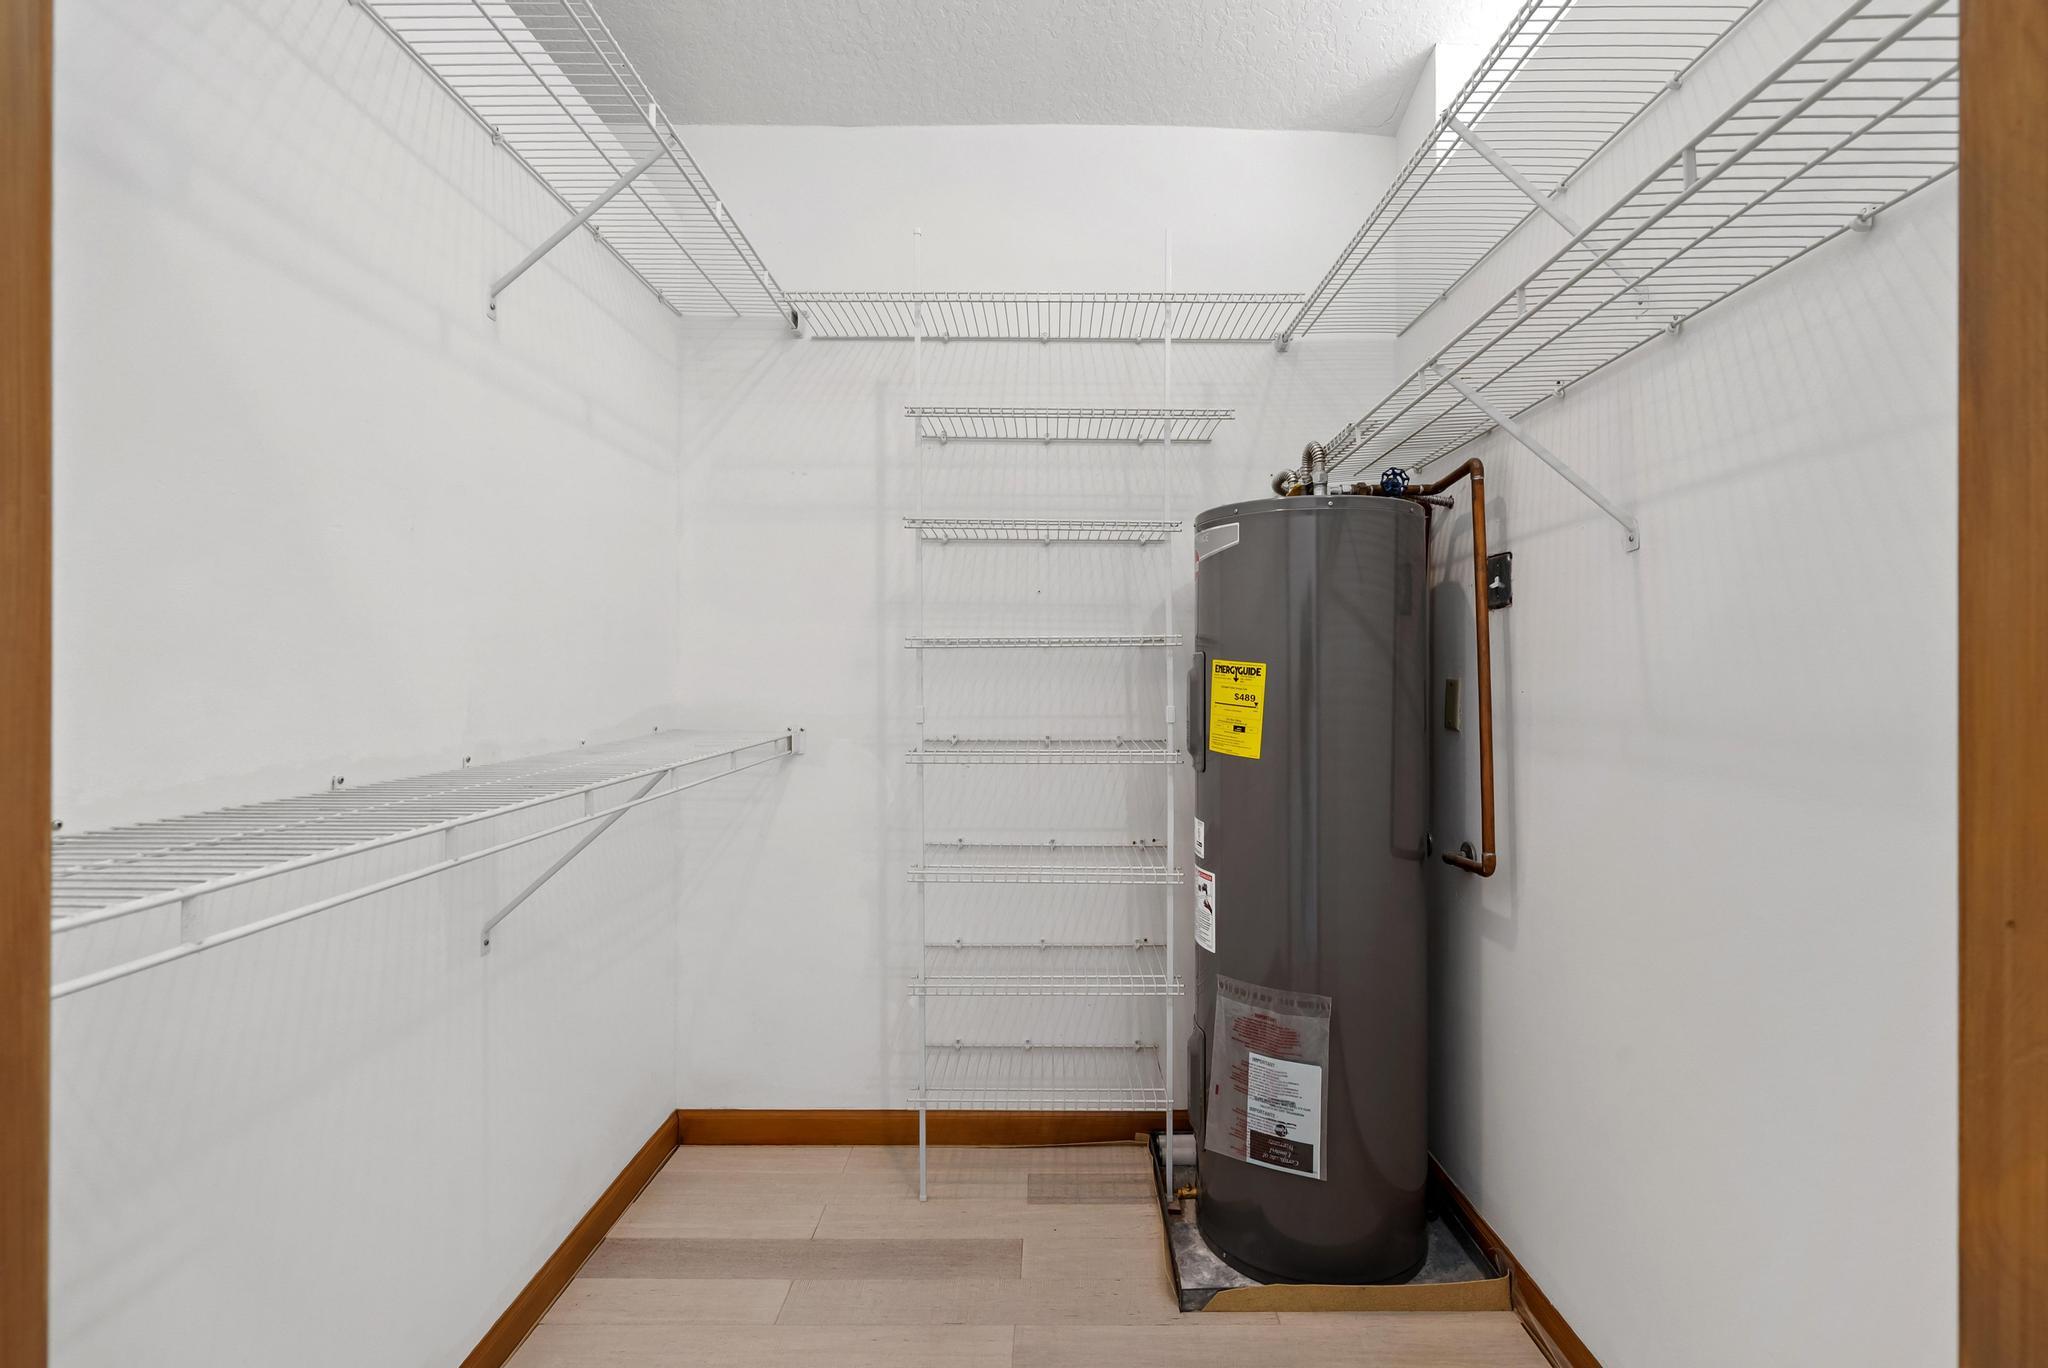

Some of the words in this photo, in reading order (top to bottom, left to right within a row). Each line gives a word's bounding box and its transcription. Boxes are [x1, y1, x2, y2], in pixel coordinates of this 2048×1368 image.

[1215, 664, 1262, 677] ENERGYGUIDE
[1234, 693, 1256, 703] $489
[1269, 1154, 1300, 1167] Certifate
